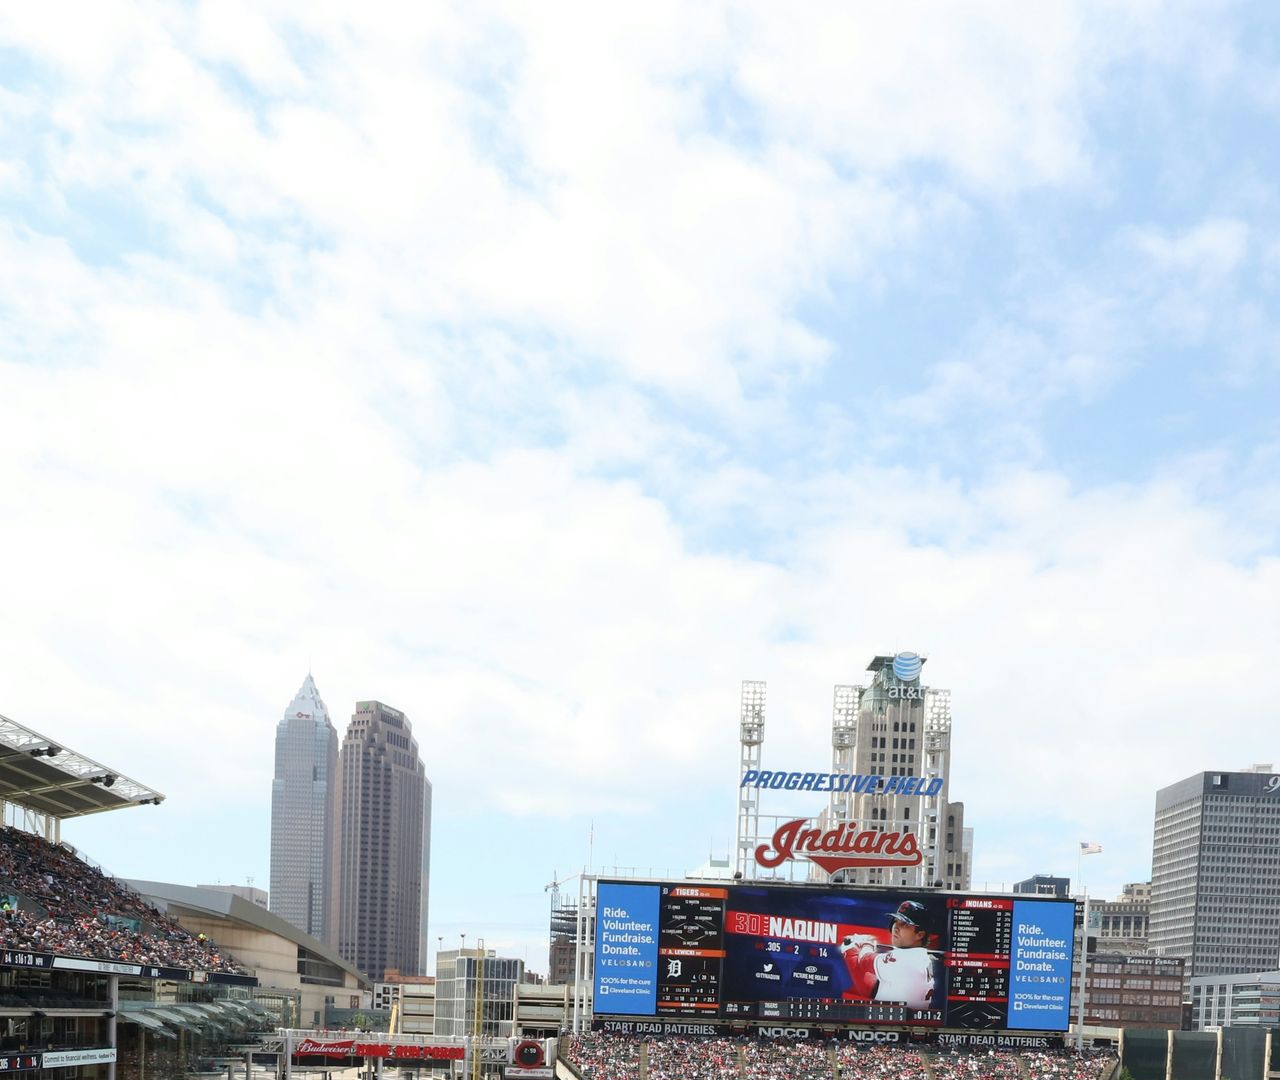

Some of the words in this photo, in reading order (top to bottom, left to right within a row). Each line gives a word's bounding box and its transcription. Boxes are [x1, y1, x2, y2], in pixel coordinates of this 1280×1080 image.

[888, 686, 923, 699] at&t
[740, 770, 883, 794] PROGRESSIVE
[883, 777, 944, 796] FIELD
[755, 819, 923, 874] Indians
[675, 888, 699, 897] TIGERS
[966, 900, 992, 908] INDIANS
[603, 908, 629, 918] Ride.
[603, 920, 653, 932] Volunteer.
[735, 913, 761, 935] 30
[769, 917, 838, 944] NAQUIN
[1018, 924, 1044, 935] Ride.
[602, 932, 655, 944] Fundraise.
[1017, 936, 1066, 948] Volunteer.
[602, 944, 641, 955] Donate.
[1017, 949, 1068, 960] Fundraise.
[601, 959, 652, 967] VELOSANO
[1016, 961, 1054, 971] Donate.
[600, 977, 619, 985] 100%
[620, 977, 628, 985] for
[1015, 975, 1065, 983] VELOSANO
[604, 1021, 633, 1032] START
[637, 1023, 662, 1033] DEAD
[665, 1024, 717, 1036] BATTERIES.
[758, 1027, 809, 1038] NOCO
[848, 1031, 899, 1042] NOCO
[938, 1033, 967, 1044] START
[970, 1035, 995, 1045] DEAD
[998, 1036, 1049, 1048] BATTERIES.
[298, 1041, 352, 1054] Budweiser
